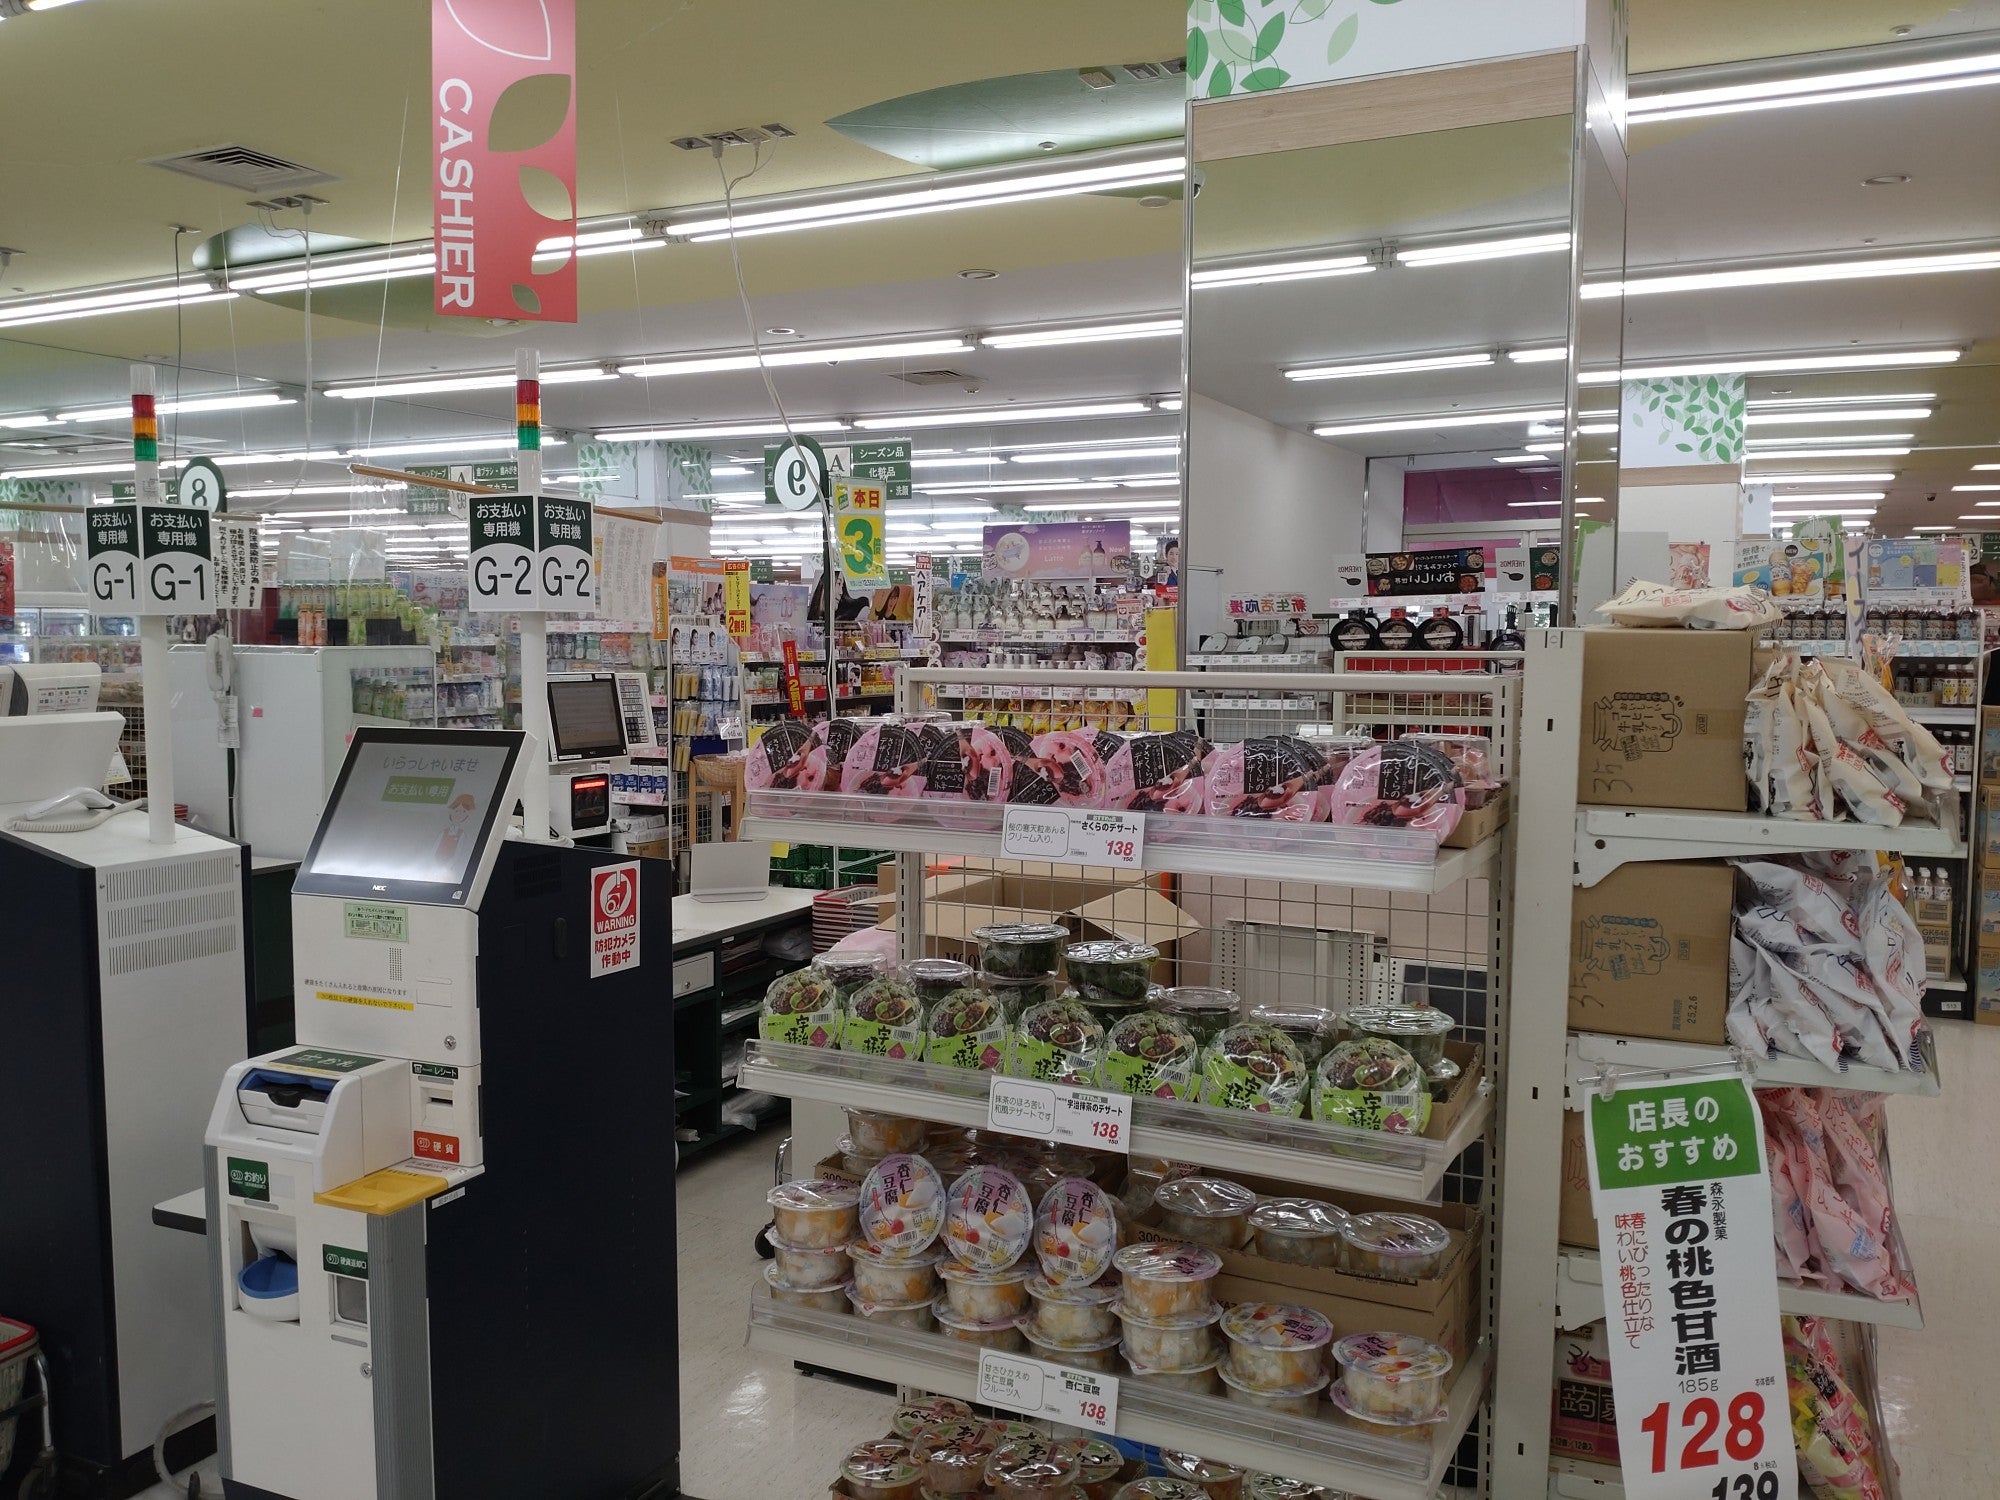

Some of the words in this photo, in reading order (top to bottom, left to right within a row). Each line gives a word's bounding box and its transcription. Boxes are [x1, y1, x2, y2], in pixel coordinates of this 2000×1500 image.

[439, 77, 475, 310] CASHIER
[860, 447, 904, 458] シーズン品
[829, 454, 845, 472] A
[869, 467, 896, 478] 化粧品
[854, 489, 880, 508] 本日
[92, 512, 132, 527] お支払い
[476, 503, 526, 518] お支払い
[544, 504, 586, 521] お支払い
[150, 512, 202, 529] お支払い
[483, 522, 521, 537] 専用機
[97, 530, 129, 545] 専用機
[157, 531, 198, 546] 専用機
[550, 523, 582, 540] 専用機
[845, 518, 874, 574] 3
[1968, 538, 1976, 547] A
[1970, 548, 1978, 560] 2
[474, 555, 532, 596] G-2
[542, 556, 590, 597] G-2
[1143, 564, 1150, 574] 9
[93, 562, 135, 601] G-1
[150, 563, 205, 602] G-1
[917, 570, 926, 617] ヘアケア
[728, 616, 747, 634] 2割引
[383, 756, 480, 773] いらっしゃいませ
[1081, 821, 1138, 834] さくらのデザート
[1107, 839, 1134, 857] 138
[372, 884, 388, 892] NEC
[596, 914, 635, 933] WARNING
[594, 932, 636, 955] 防犯カメラ
[601, 949, 631, 969] 作動中
[1687, 996, 1698, 1024] 25.2.6
[434, 1066, 457, 1077] レシート
[995, 1094, 1046, 1110] 抹茶のほろ苦い
[1067, 1099, 1123, 1117] 宇治抹茶のデザート
[994, 1103, 1052, 1121] 和風デザートです
[1628, 1096, 1720, 1134] 店長の
[1092, 1121, 1120, 1139] 138
[1617, 1133, 1738, 1171] おすすめ
[244, 1171, 267, 1184] お釣り
[1709, 1181, 1728, 1241] 森永製菓
[1630, 1212, 1655, 1332] 春にぴったりな
[1661, 1184, 1721, 1376] 春の桃色甘酒
[1614, 1214, 1641, 1350] 味わい桃色仕立て
[984, 1363, 1030, 1381] 甘さひかえめ
[984, 1373, 1014, 1388] 杏仁豆腐
[983, 1383, 1021, 1400] フルーツ入
[1065, 1380, 1101, 1396] 杏仁豆腐
[1678, 1377, 1719, 1394] 185g
[1080, 1401, 1106, 1420] 138
[1641, 1391, 1766, 1474] 128
